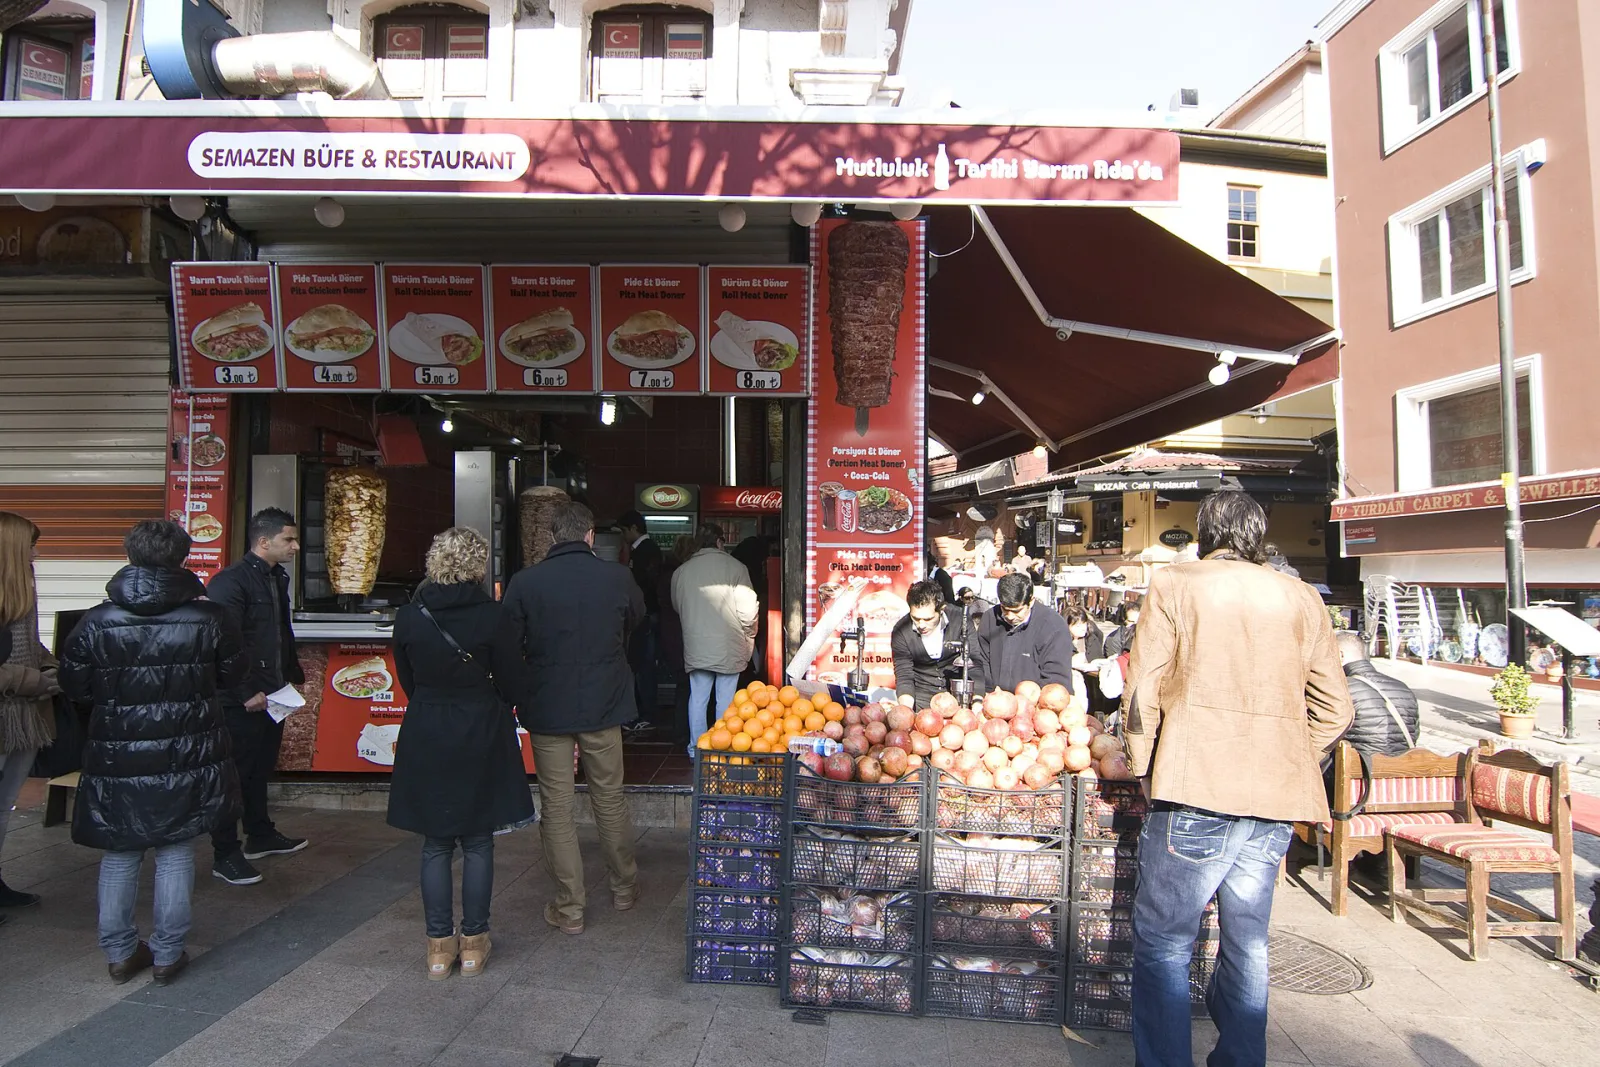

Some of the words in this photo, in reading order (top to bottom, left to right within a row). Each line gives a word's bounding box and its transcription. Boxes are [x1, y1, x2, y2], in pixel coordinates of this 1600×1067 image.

[23, 67, 64, 86] SEMAZEN
[201, 147, 295, 167] SEMAZEN
[303, 143, 354, 168] BÜFE
[361, 149, 377, 168] &
[385, 149, 516, 170] RESTAURANT
[835, 156, 929, 178] Mutluluk
[954, 158, 1017, 179] Tarihi
[1022, 158, 1088, 181] Yarım
[217, 276, 242, 284] Tavuk
[243, 275, 268, 284] Döner
[292, 274, 310, 283] Pide
[311, 274, 338, 283] Tavuk
[339, 274, 363, 283] Döner
[392, 275, 420, 284] Dürüm
[422, 275, 448, 284] Tavuk
[449, 275, 474, 285] Döner
[511, 276, 537, 286] Yarım
[538, 277, 549, 286] Et
[550, 277, 575, 286] Döner
[624, 278, 642, 287] Pide
[644, 278, 655, 287] Et
[656, 278, 681, 287] Döner
[721, 278, 750, 287] Dürüm
[751, 278, 762, 287] Et
[763, 278, 789, 288] Döner
[619, 290, 637, 299] Pita
[638, 290, 660, 299] Meat
[661, 290, 685, 299] Doner
[722, 291, 738, 299] Roll
[740, 291, 763, 300] Meat
[764, 291, 788, 300] Doner
[222, 367, 243, 384] 3.00
[321, 367, 342, 383] 4.00
[422, 367, 443, 384] 5.00
[532, 369, 554, 386] 6.00
[638, 370, 661, 387] 7.00
[743, 371, 765, 388] 8.00
[832, 446, 866, 457] Porsiyon
[867, 447, 877, 455] Et
[878, 447, 901, 456] Döner
[827, 459, 858, 468] (Portion
[860, 459, 879, 468] Meat
[880, 459, 907, 469] Doner)
[850, 471, 890, 480] Coca-Cola
[1152, 480, 1198, 489] Restaurant
[1352, 499, 1405, 517] YURDAN
[1413, 491, 1474, 511] CARPET
[1484, 489, 1499, 504] &
[1519, 477, 1600, 500] EWELLE
[857, 550, 868, 559] Et
[869, 550, 895, 559] Döner
[828, 562, 850, 572] (Pita
[852, 562, 873, 571] Meat
[874, 562, 904, 573] Doner)
